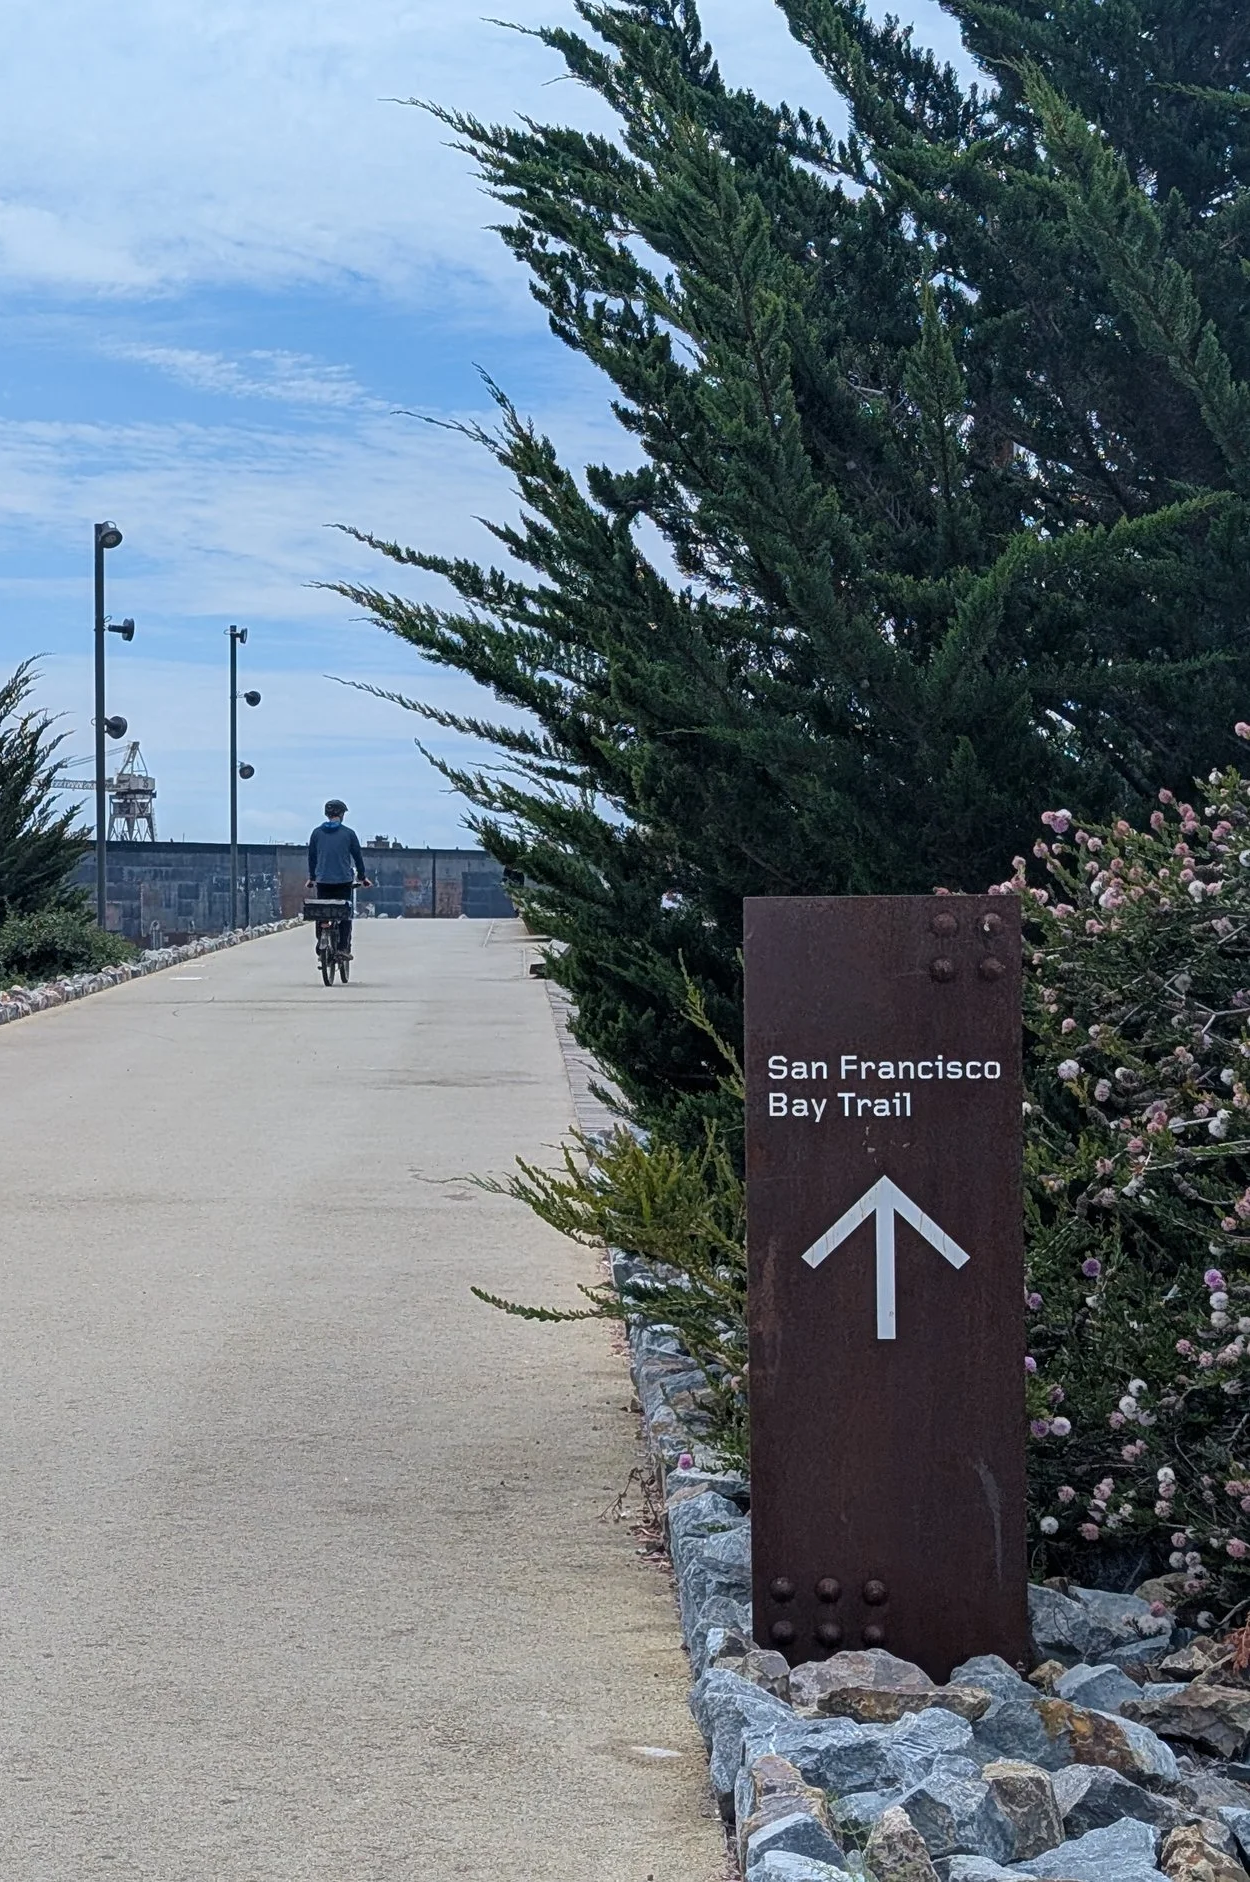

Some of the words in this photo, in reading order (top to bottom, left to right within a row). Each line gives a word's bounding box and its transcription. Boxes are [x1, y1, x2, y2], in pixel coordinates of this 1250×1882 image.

[768, 1055, 828, 1080] San
[840, 1054, 1001, 1080] Francisco
[768, 1092, 827, 1122] Bay
[837, 1092, 911, 1117] Trail
